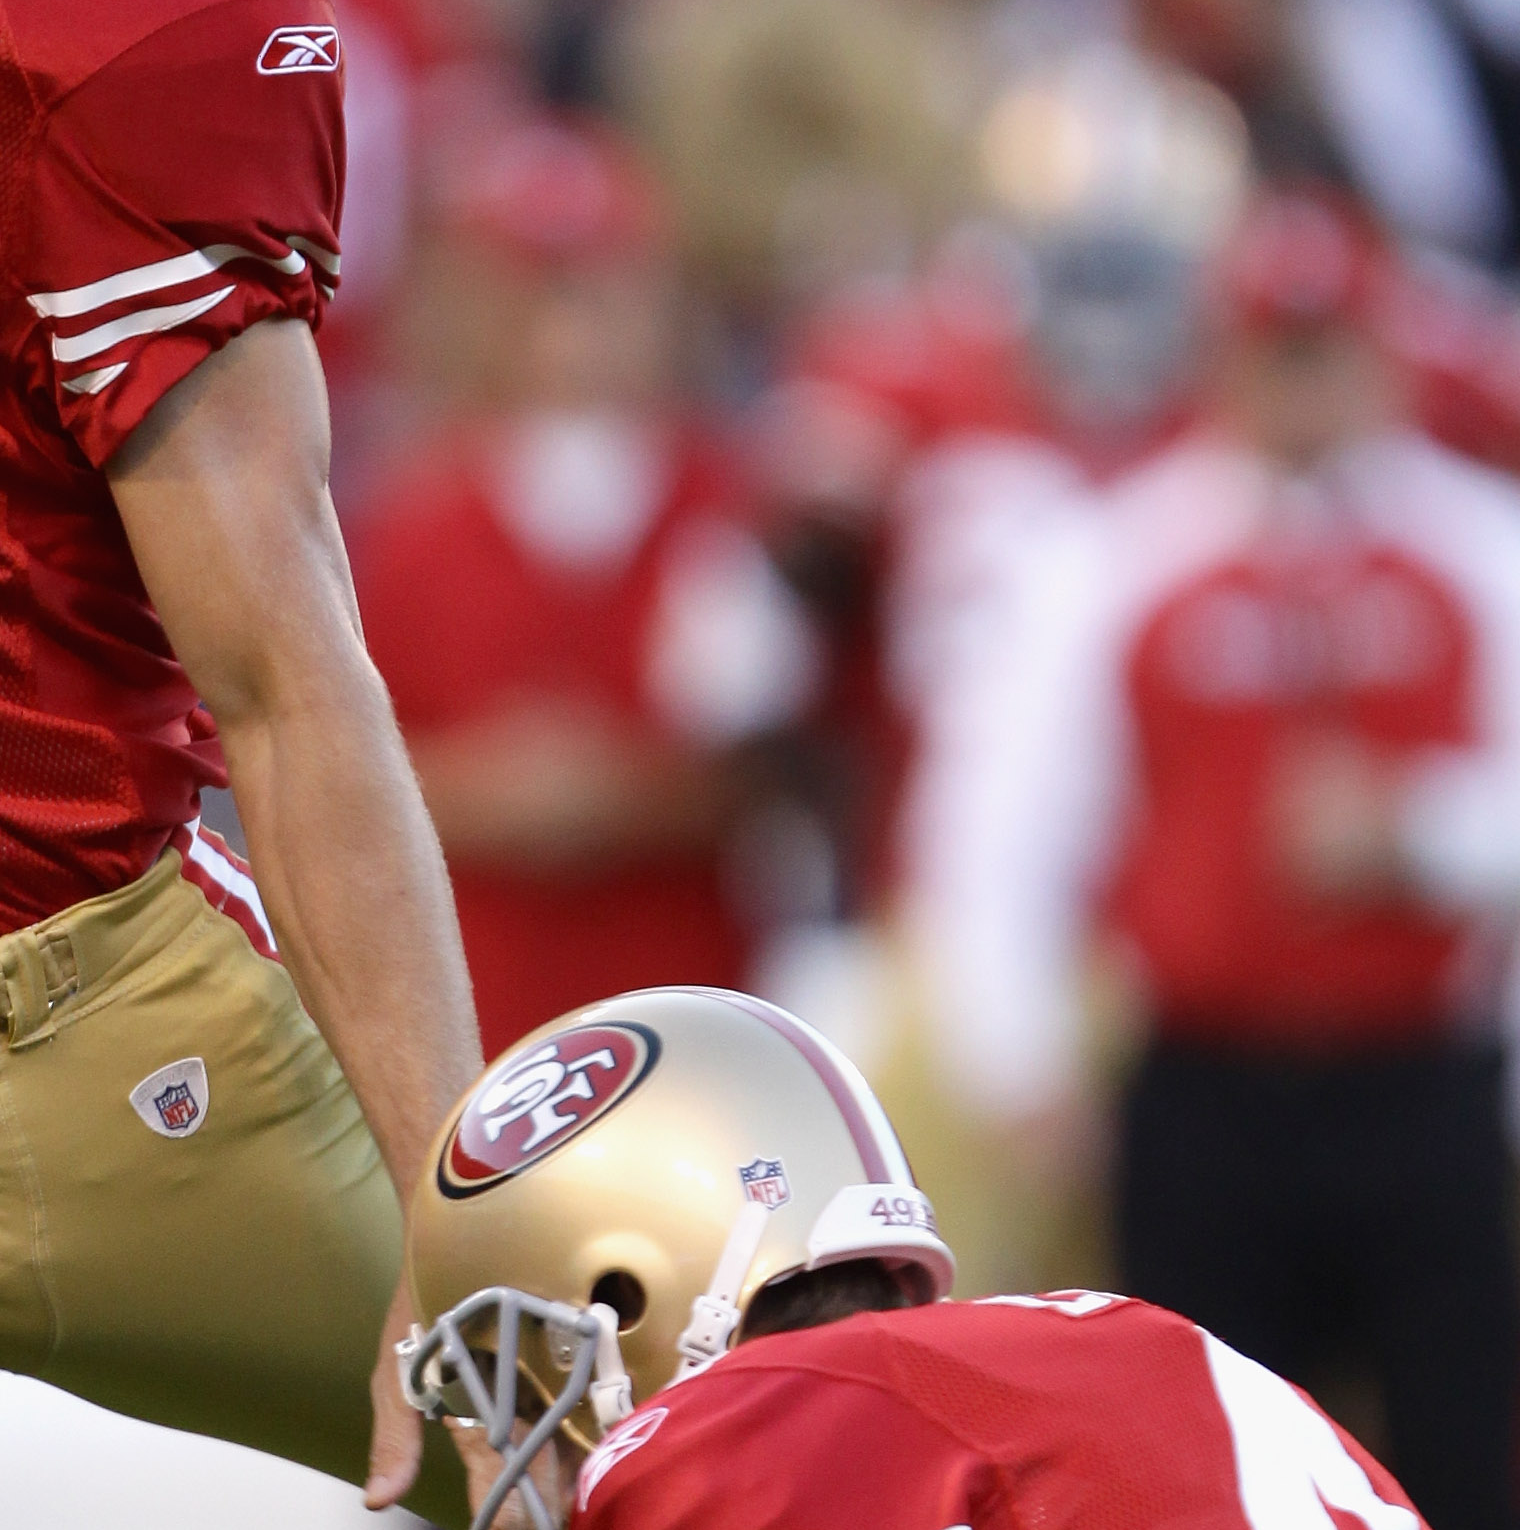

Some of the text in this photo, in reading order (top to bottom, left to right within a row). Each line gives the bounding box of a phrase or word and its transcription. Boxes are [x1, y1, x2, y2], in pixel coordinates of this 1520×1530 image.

[163, 1098, 196, 1126] NFL
[480, 1043, 616, 1154] SF
[748, 1180, 786, 1206] NFL
